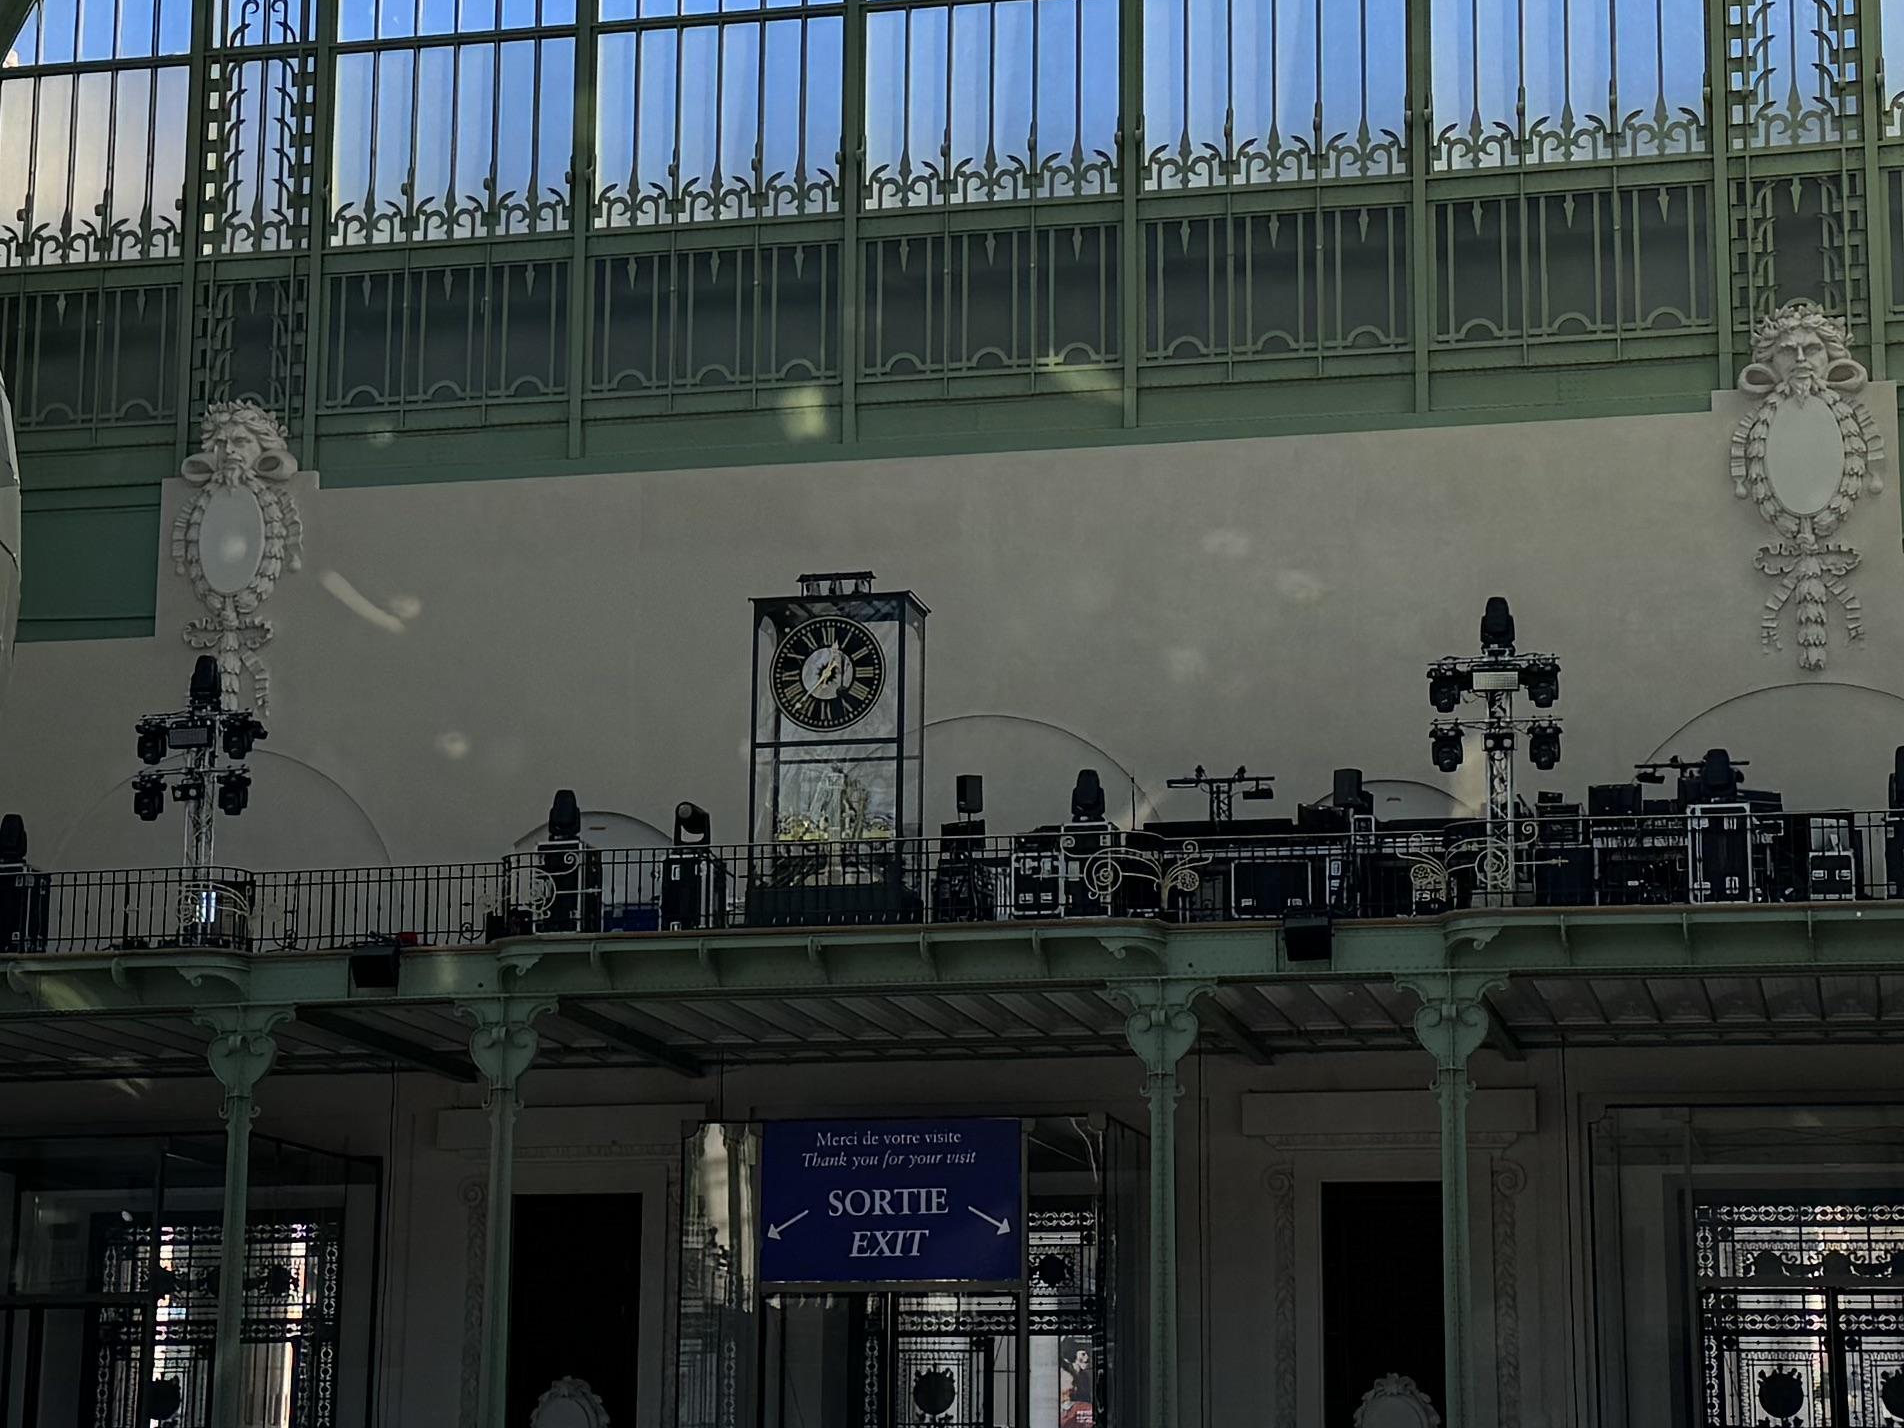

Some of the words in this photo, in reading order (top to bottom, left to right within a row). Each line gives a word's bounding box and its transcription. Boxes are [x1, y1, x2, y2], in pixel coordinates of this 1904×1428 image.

[816, 1131, 858, 1147] Merci
[862, 1130, 880, 1145] de
[883, 1133, 921, 1145] votre
[925, 1130, 962, 1144] visite
[802, 1151, 847, 1168] Thank
[851, 1154, 879, 1170] you
[882, 1149, 905, 1169] for
[908, 1153, 943, 1169] your
[946, 1150, 977, 1164] visit
[828, 1187, 949, 1217] SORTIE
[849, 1229, 929, 1257] EXIT
